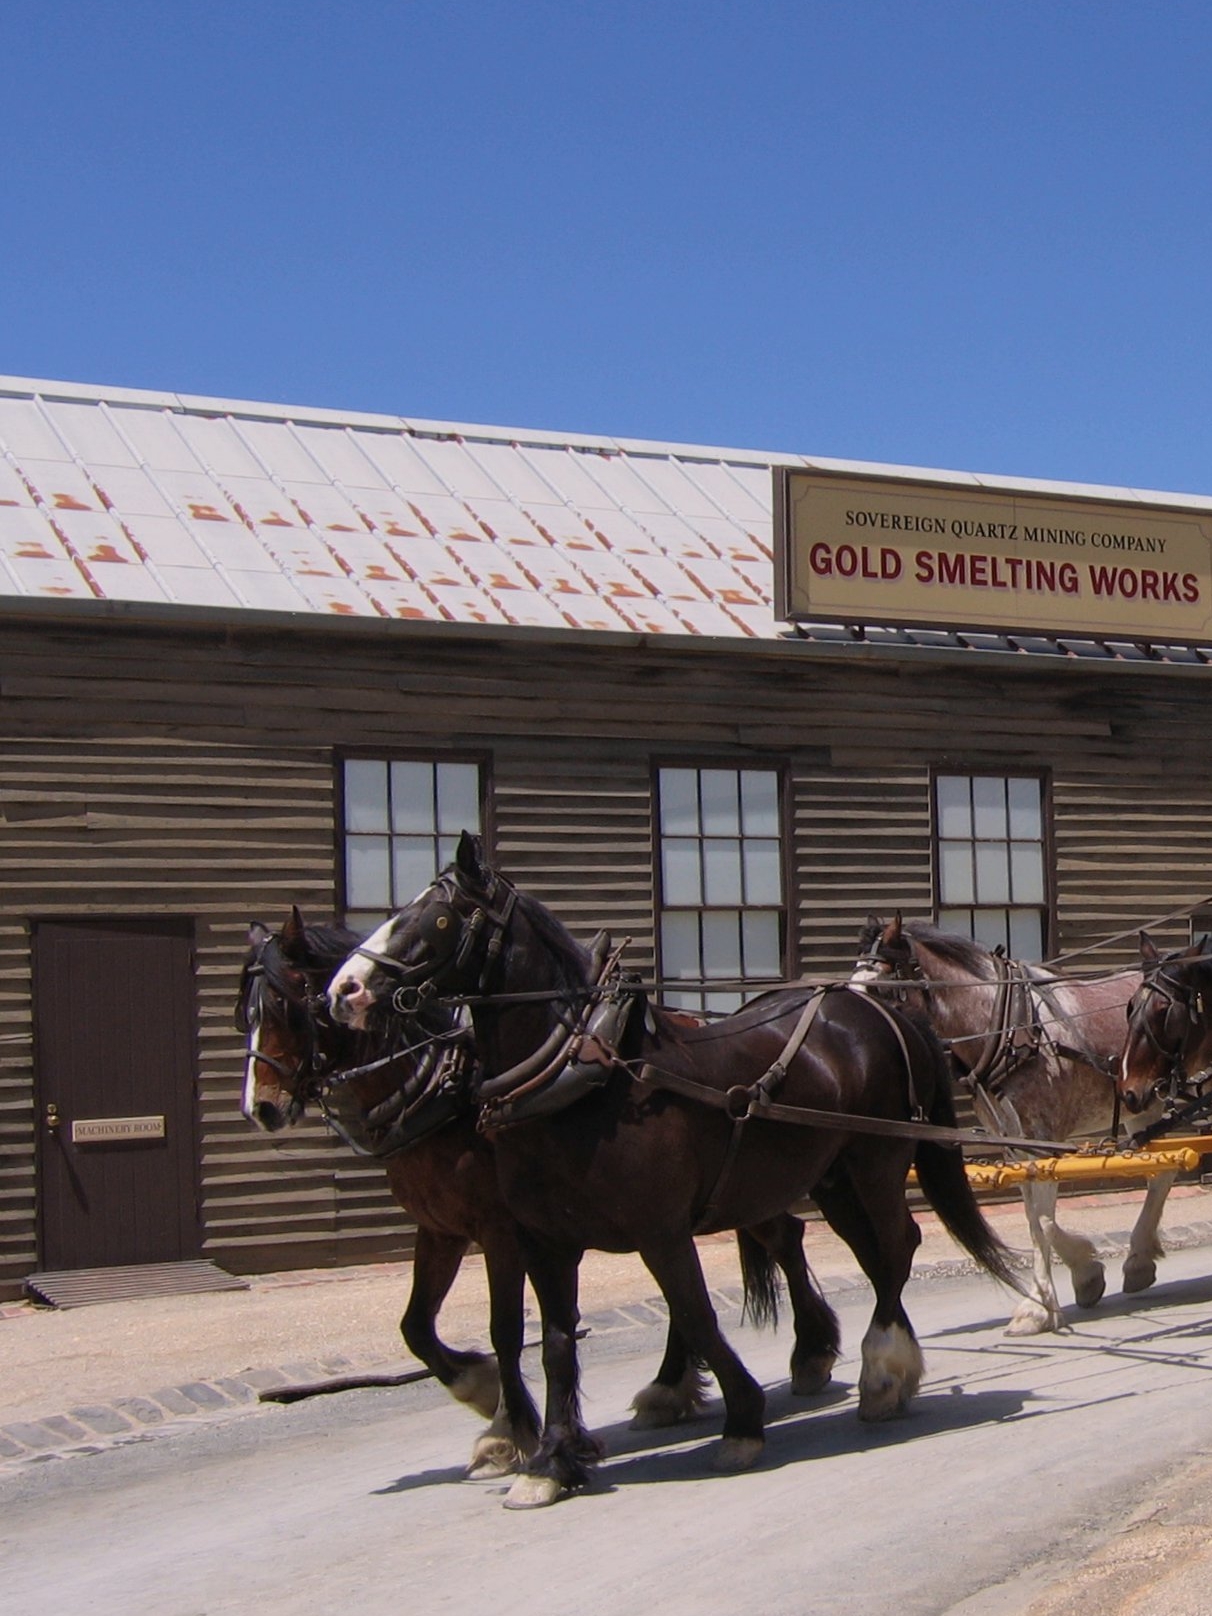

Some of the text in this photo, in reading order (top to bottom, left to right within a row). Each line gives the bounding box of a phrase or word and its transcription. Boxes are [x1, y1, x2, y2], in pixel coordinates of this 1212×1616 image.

[845, 510, 1167, 553] SOVEREIGN QUARTZ MINING COMPANY
[809, 542, 1200, 603] GOLD SMELTING WORKS
[77, 1124, 131, 1136] MACHINERY
